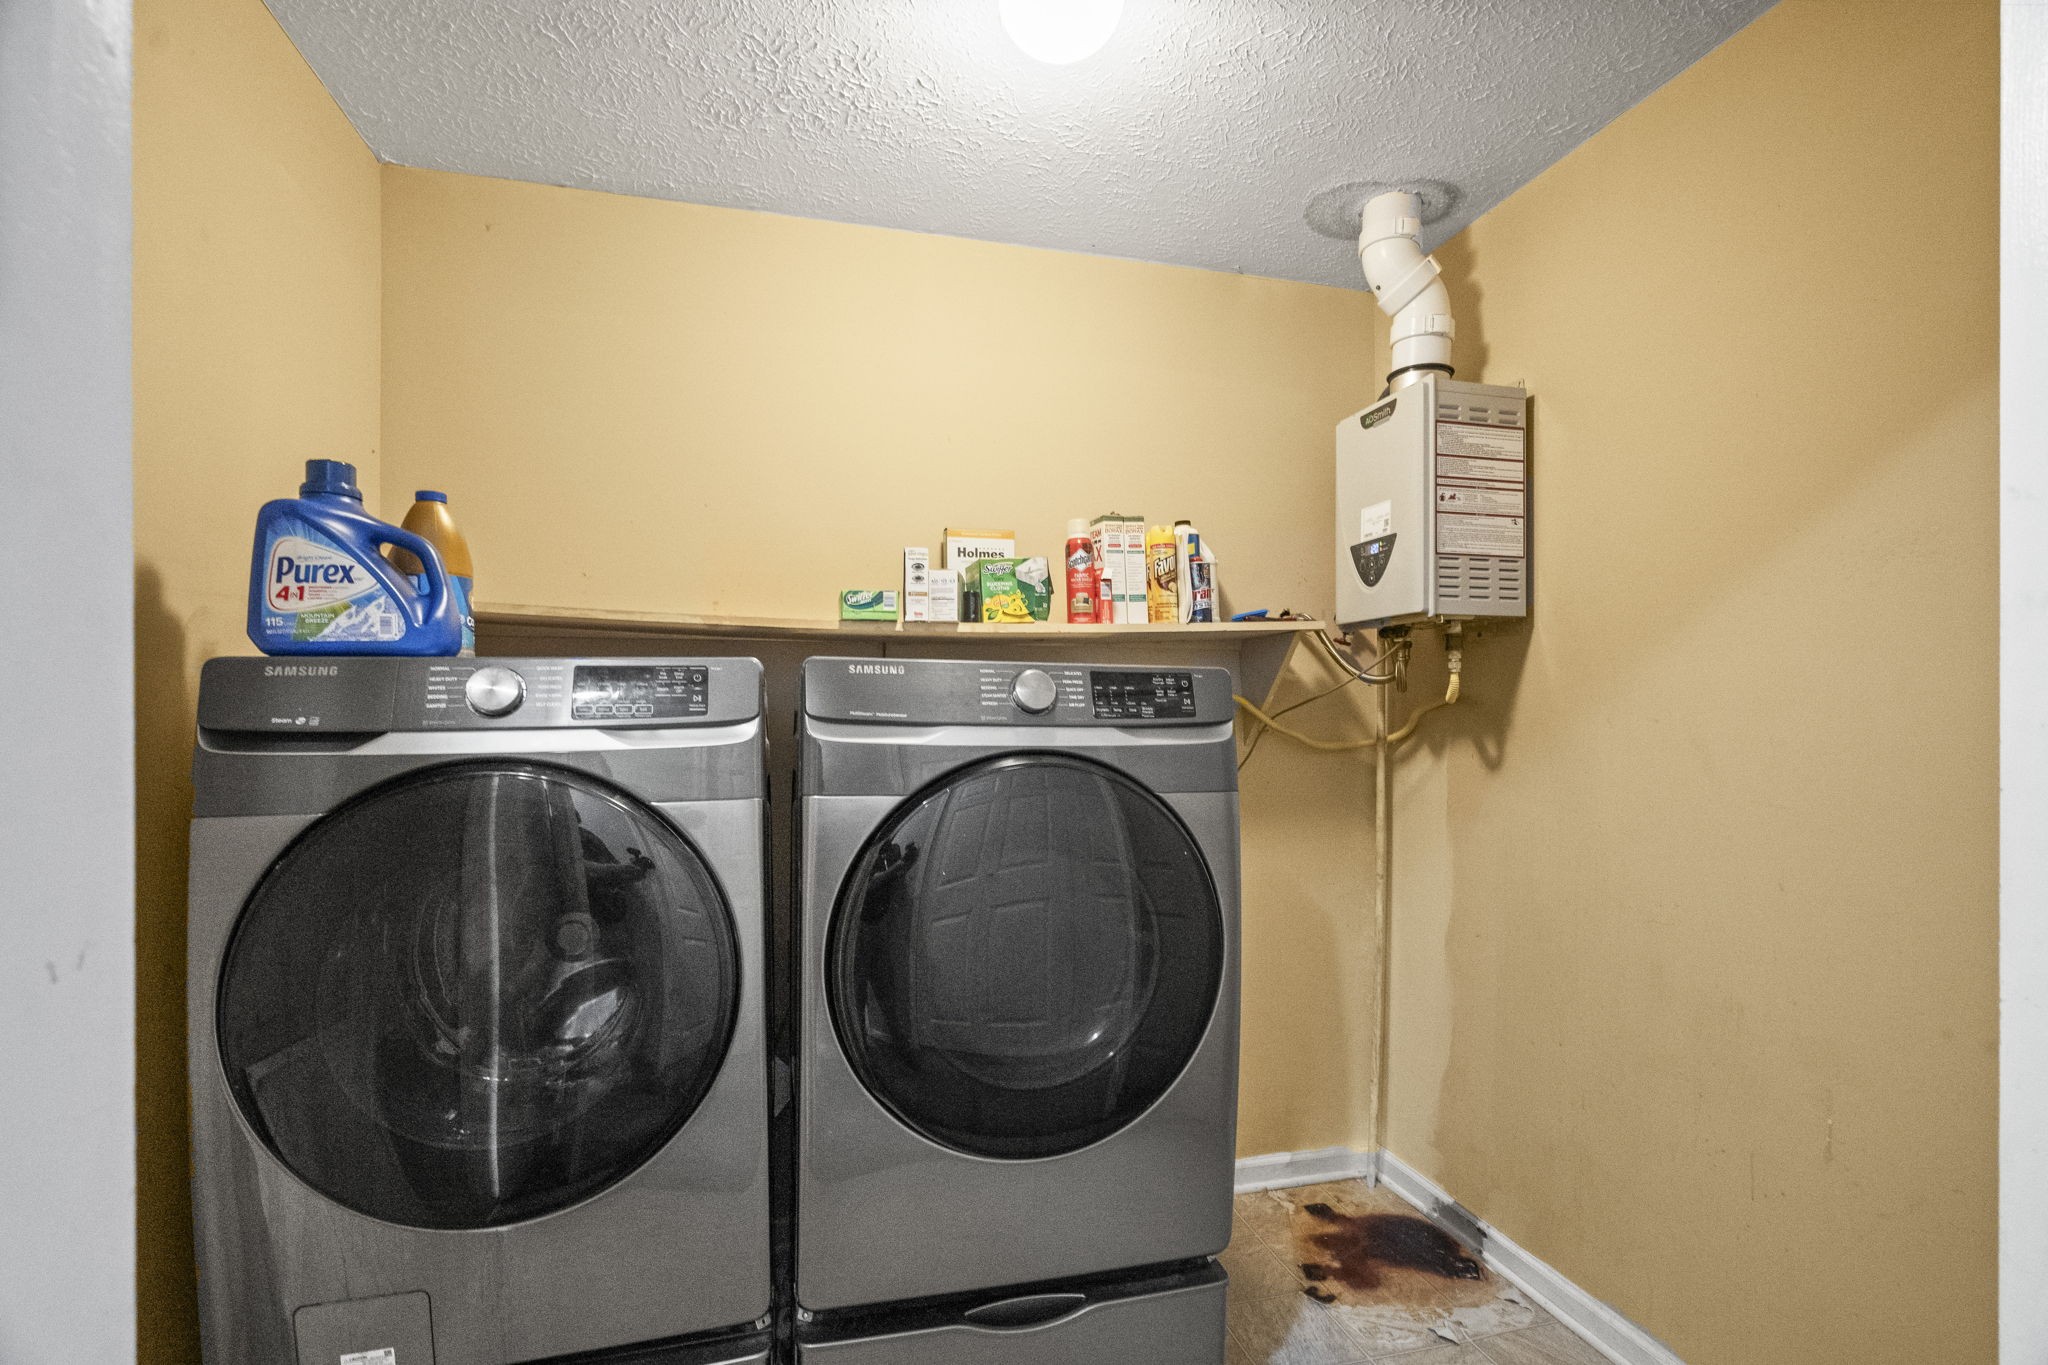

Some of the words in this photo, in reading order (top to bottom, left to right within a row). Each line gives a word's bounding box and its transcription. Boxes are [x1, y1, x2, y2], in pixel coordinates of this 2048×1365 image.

[957, 547, 1005, 558] Holmes
[276, 556, 355, 584] Purex
[266, 617, 284, 627] 115
[264, 666, 338, 677] SAMSUNG
[848, 664, 905, 675] SAMSUNG
